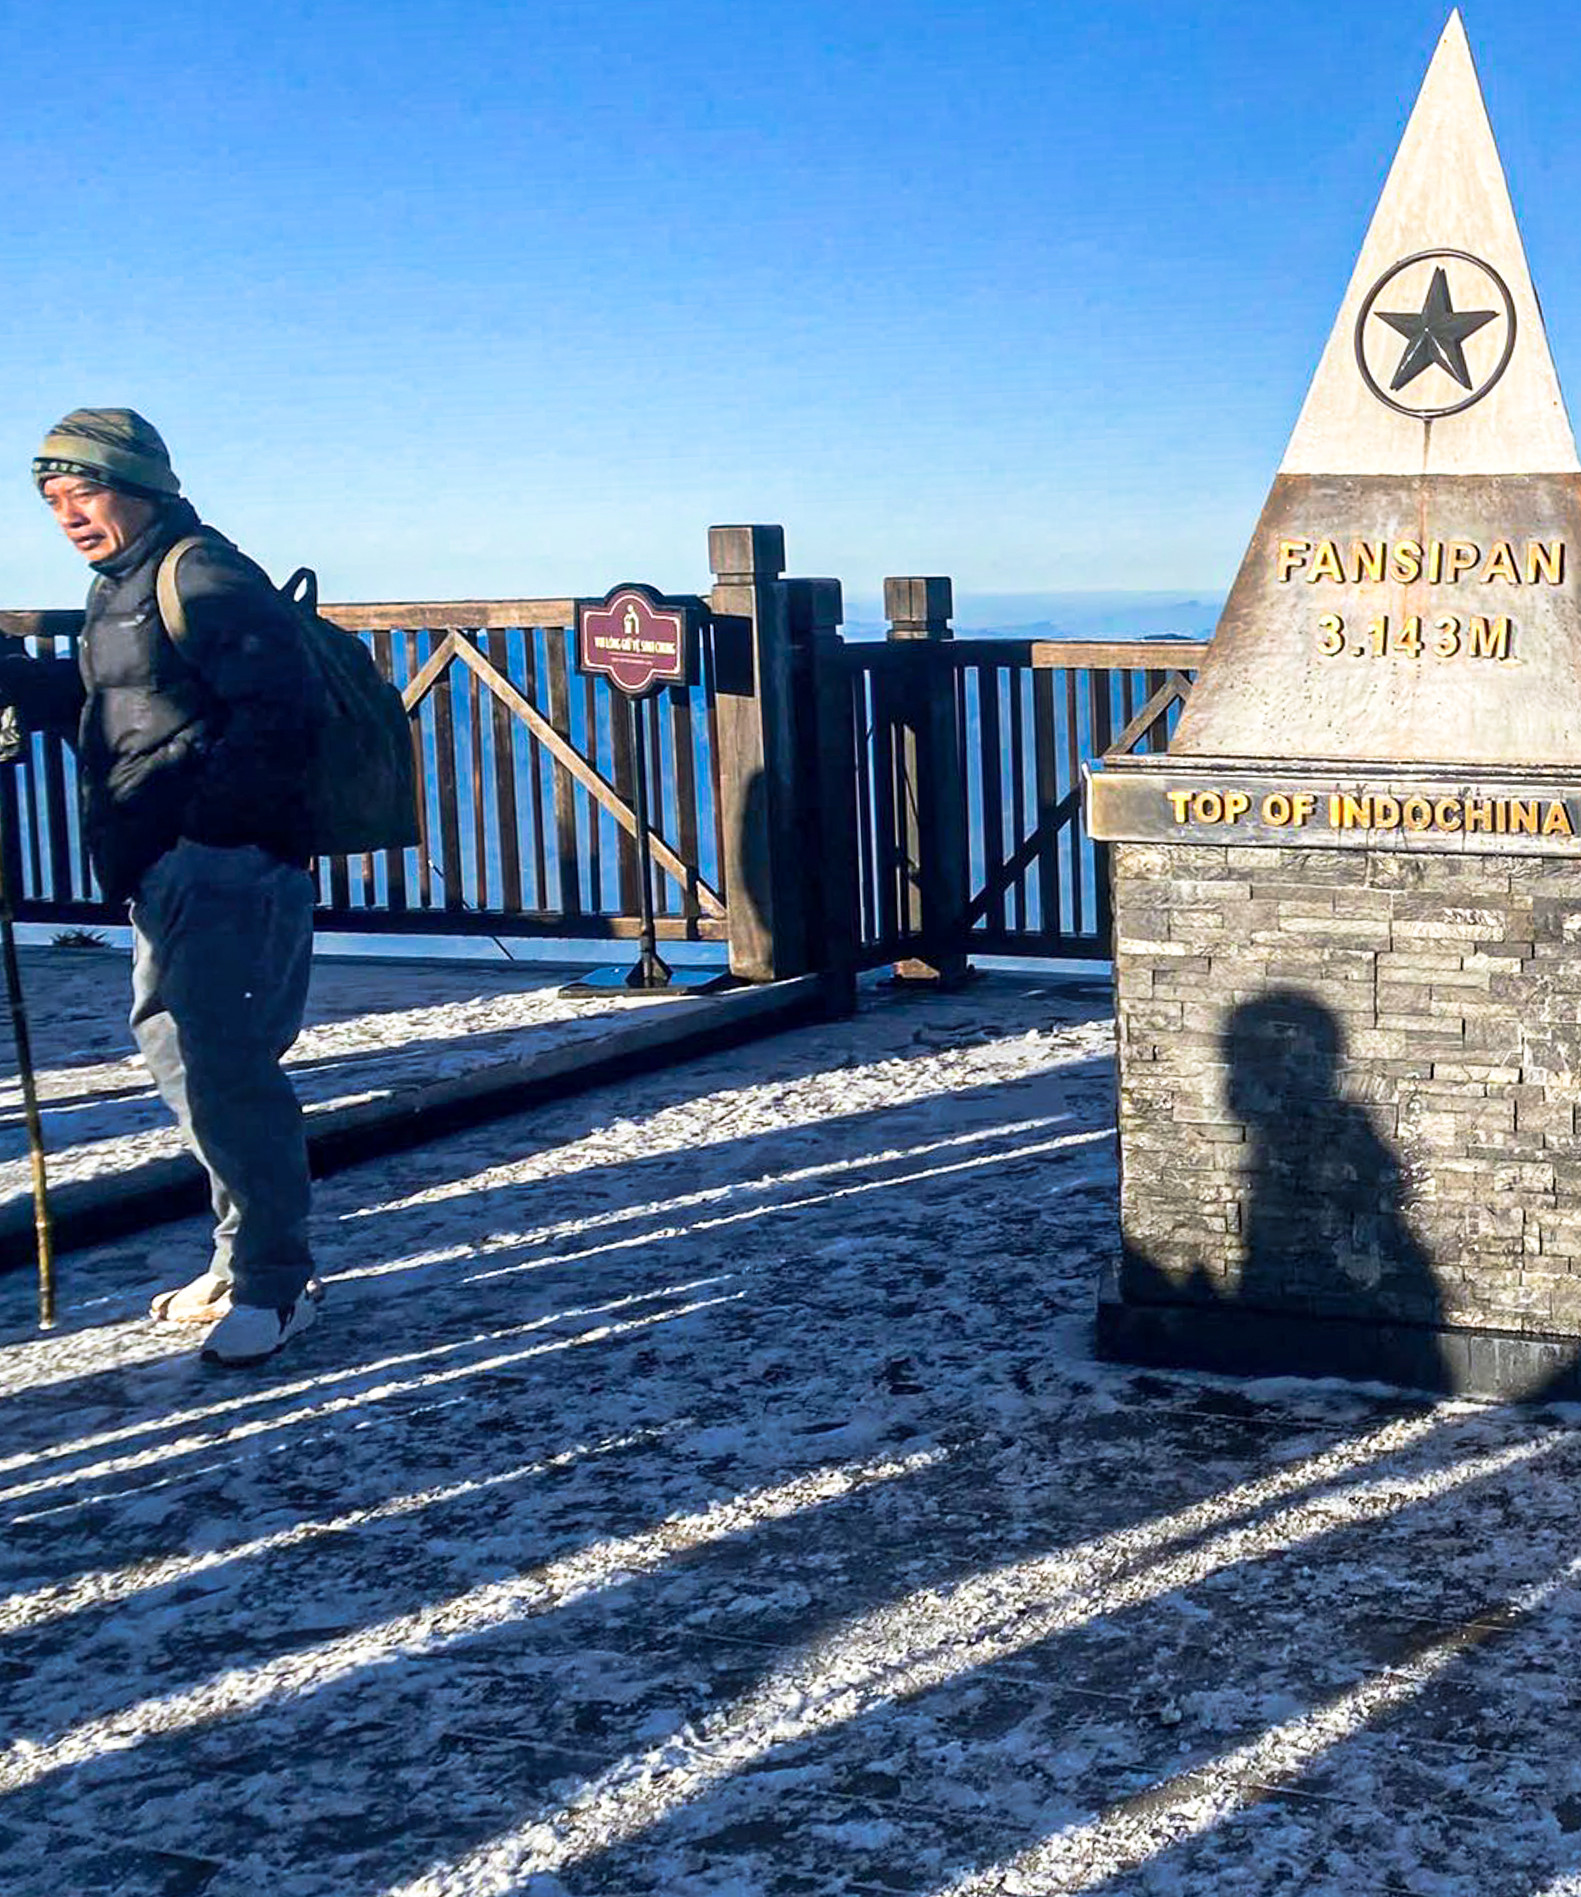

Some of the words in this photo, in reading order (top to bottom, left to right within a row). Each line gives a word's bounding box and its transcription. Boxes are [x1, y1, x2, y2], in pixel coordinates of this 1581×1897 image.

[1277, 540, 1566, 586] FANSIPAN
[1317, 613, 1513, 660] 3.143M
[1167, 791, 1250, 824] TOP
[1262, 793, 1316, 827] OF
[1328, 794, 1574, 836] INDOCHINA
